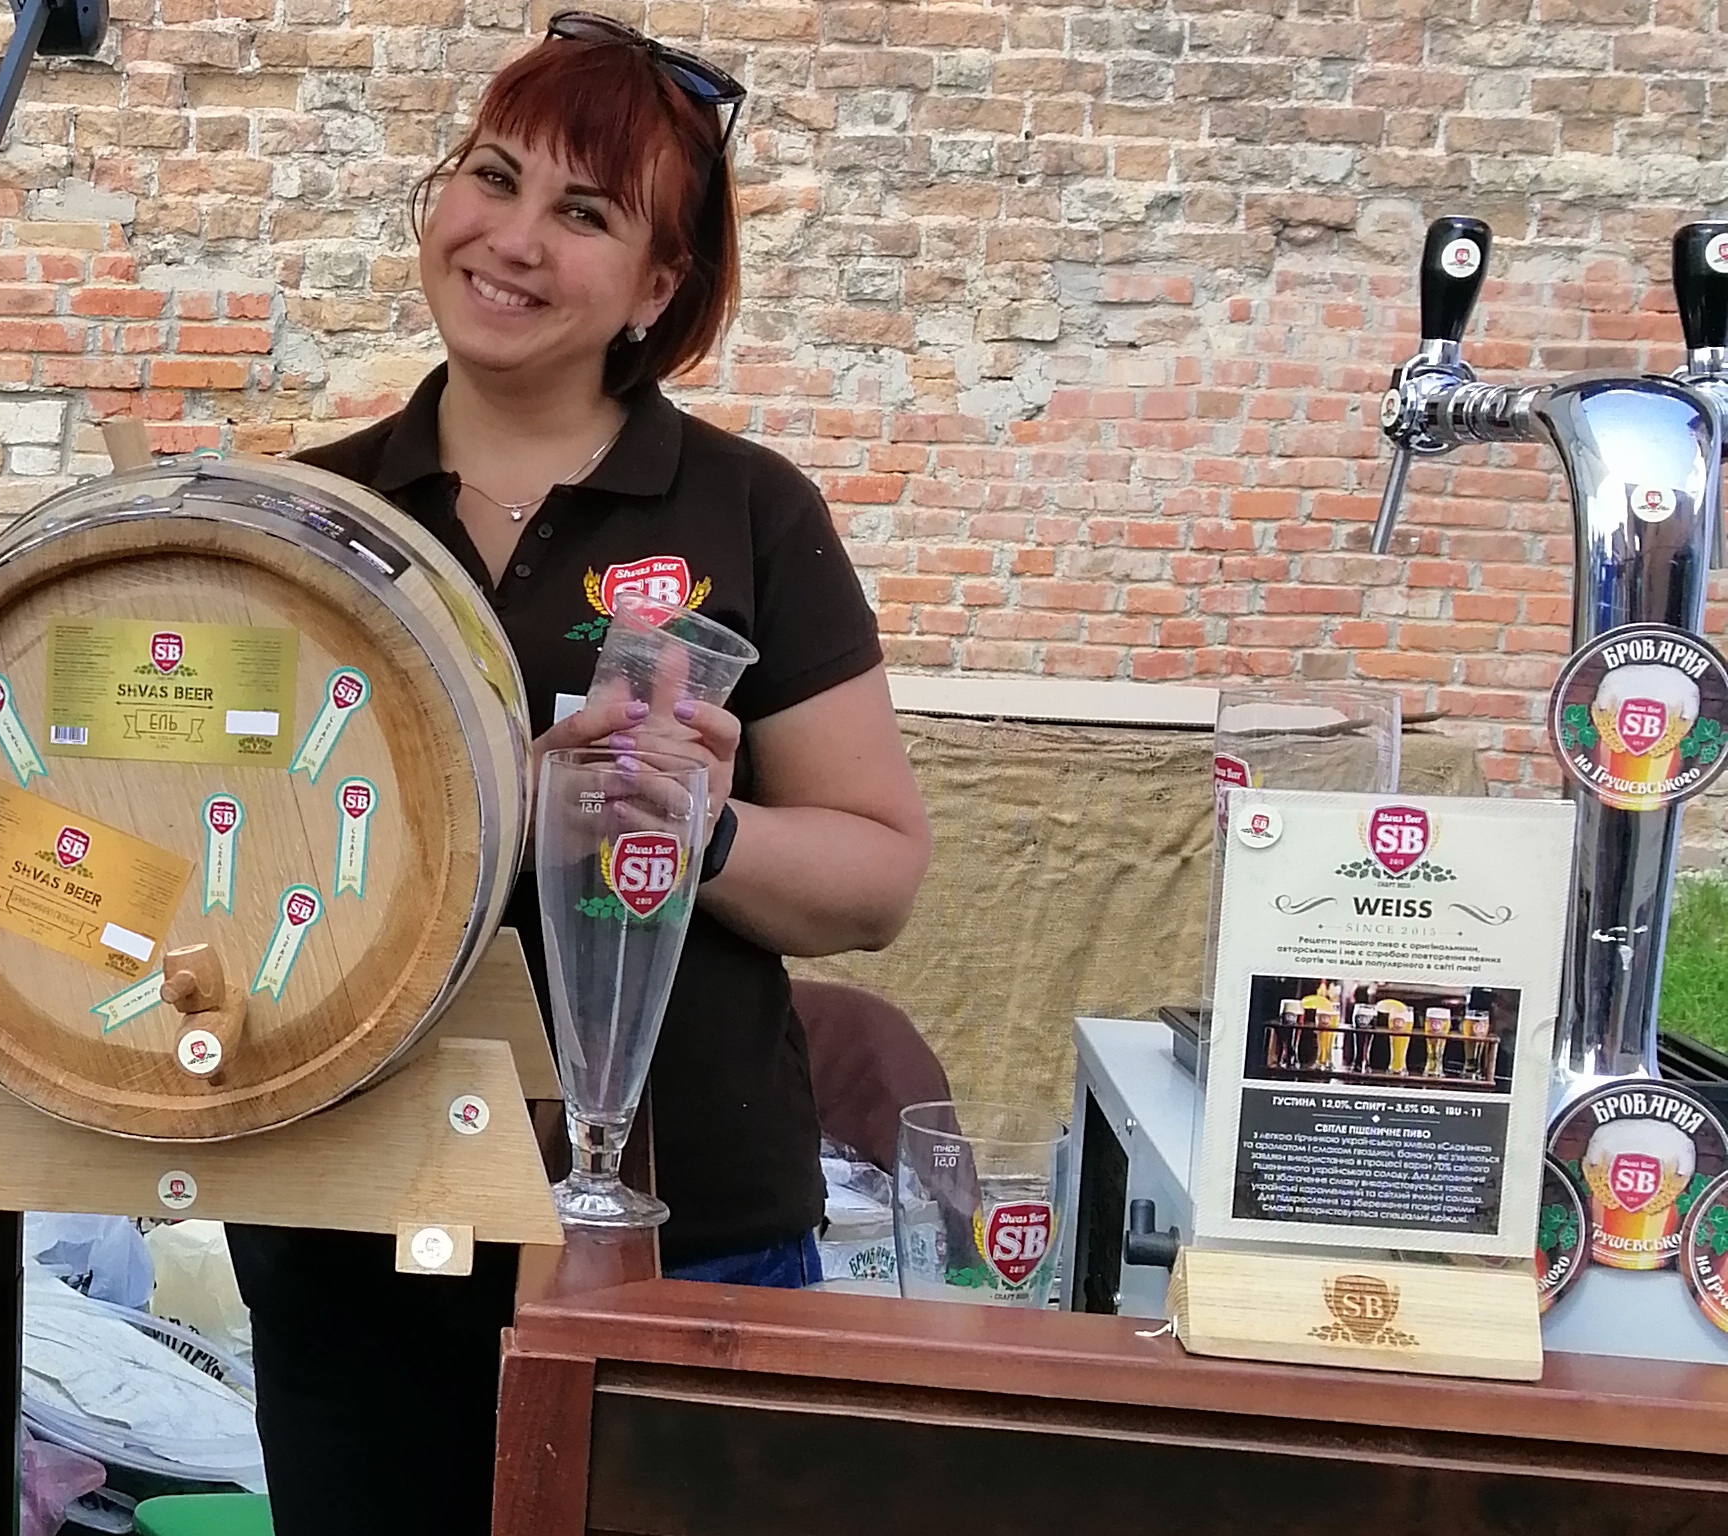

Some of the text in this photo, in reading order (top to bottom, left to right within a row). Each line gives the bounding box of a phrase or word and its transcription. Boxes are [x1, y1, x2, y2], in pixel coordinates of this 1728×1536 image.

[614, 560, 681, 579] Shvas Beer
[154, 644, 181, 661] SB
[1601, 638, 1710, 679] БРОВАРНЯ
[117, 683, 213, 702] SHVAS BEER
[333, 683, 359, 703] SB
[149, 713, 178, 731] ЕЛЬ
[1622, 713, 1661, 737] SB
[1574, 754, 1701, 794] на Грушевського
[345, 793, 368, 810] SB
[212, 809, 234, 826] SB
[59, 836, 85, 859] SB
[624, 843, 674, 856] Shvas Beer
[1374, 825, 1425, 855] SB
[11, 859, 61, 890] SHVAS
[63, 881, 103, 908] BEER
[618, 856, 675, 892] SB
[287, 901, 312, 920] SB
[1352, 896, 1433, 919] WEISS
[1345, 922, 1437, 936] SINCE 2015
[1272, 1096, 1316, 1108] ГУСТИНА
[1354, 1100, 1387, 1112] СПИРТ
[1445, 1105, 1462, 1116] IBU
[1471, 1108, 1482, 1118] 11
[1591, 1092, 1705, 1135] БРОВАРНЯ
[1403, 1128, 1432, 1139] ПИВО
[1614, 1168, 1655, 1194] SB
[998, 1212, 1048, 1225] Shvas Beer
[992, 1223, 1048, 1262] SB
[1695, 1254, 1710, 1275] на
[1342, 1293, 1384, 1319] SB
